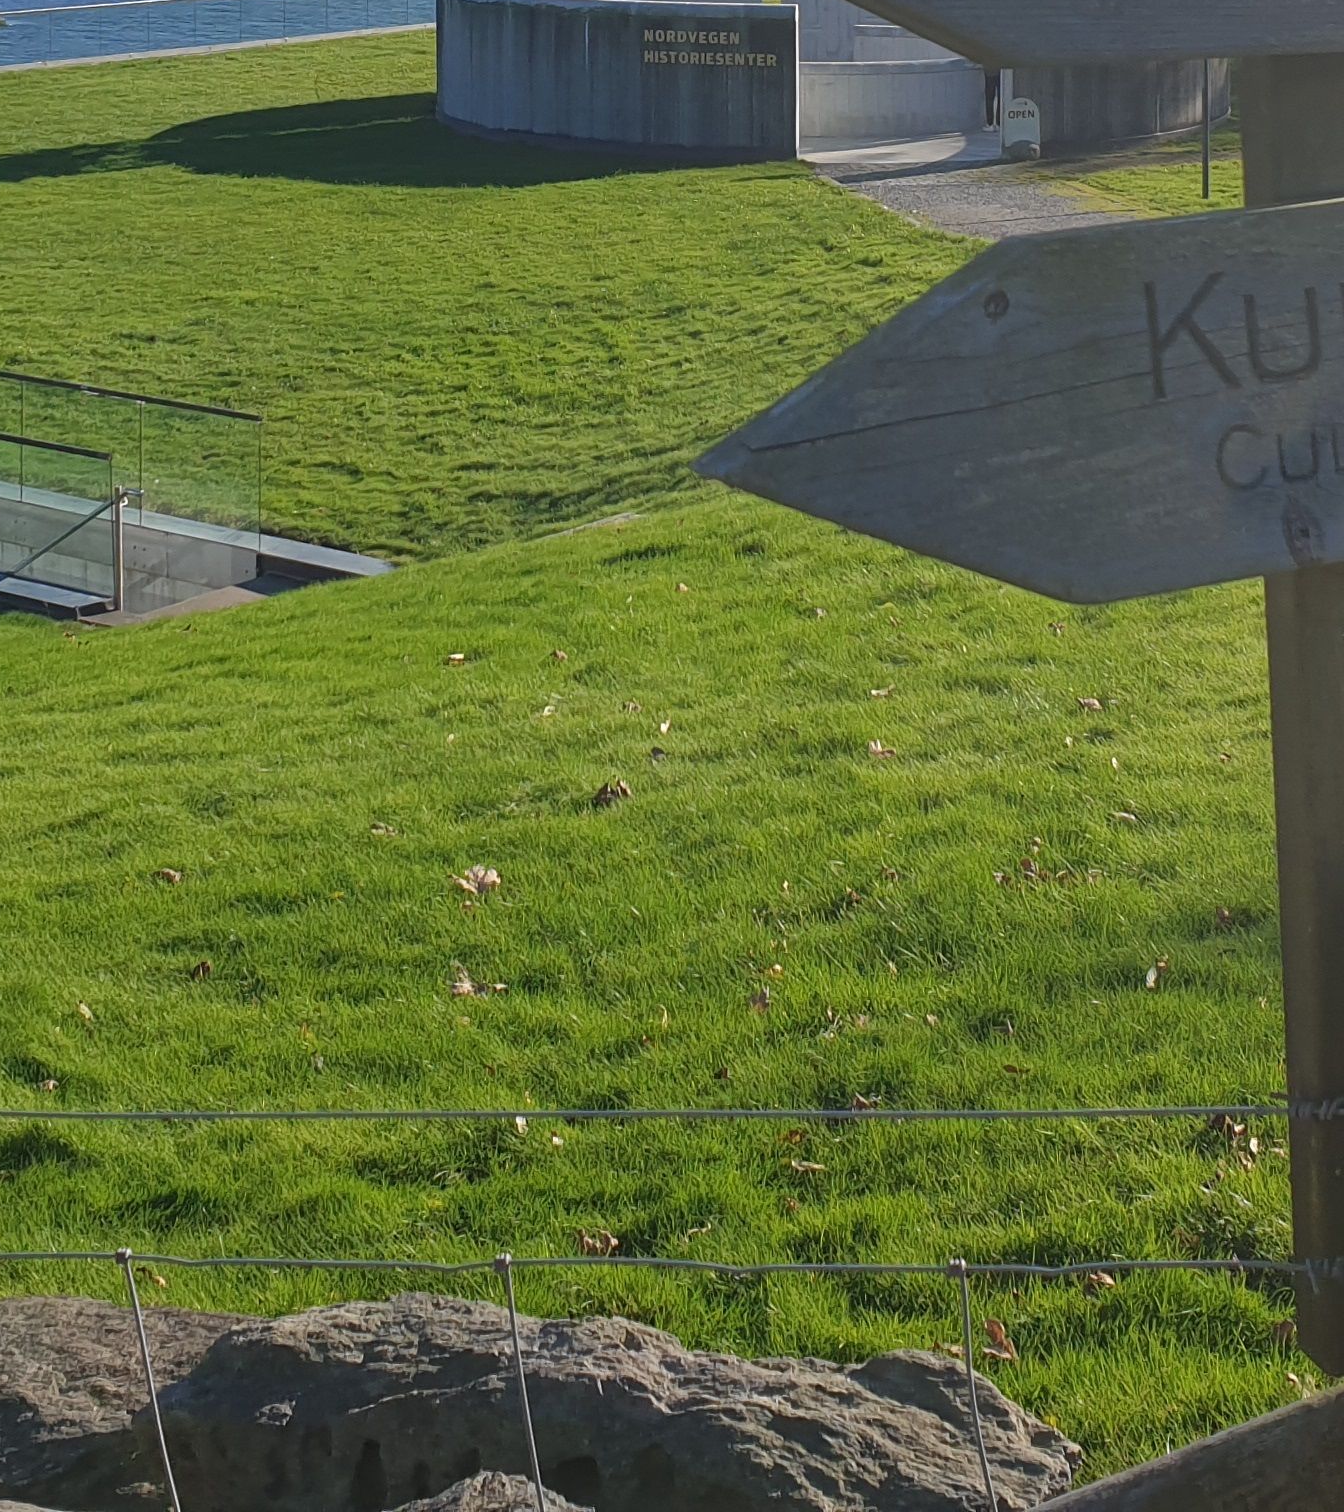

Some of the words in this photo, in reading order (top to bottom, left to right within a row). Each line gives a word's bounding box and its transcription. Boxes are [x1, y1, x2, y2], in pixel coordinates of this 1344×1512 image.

[644, 29, 740, 45] NORDVEGEN
[644, 50, 777, 67] HISTORIESENTER
[1008, 109, 1035, 119] OPEN
